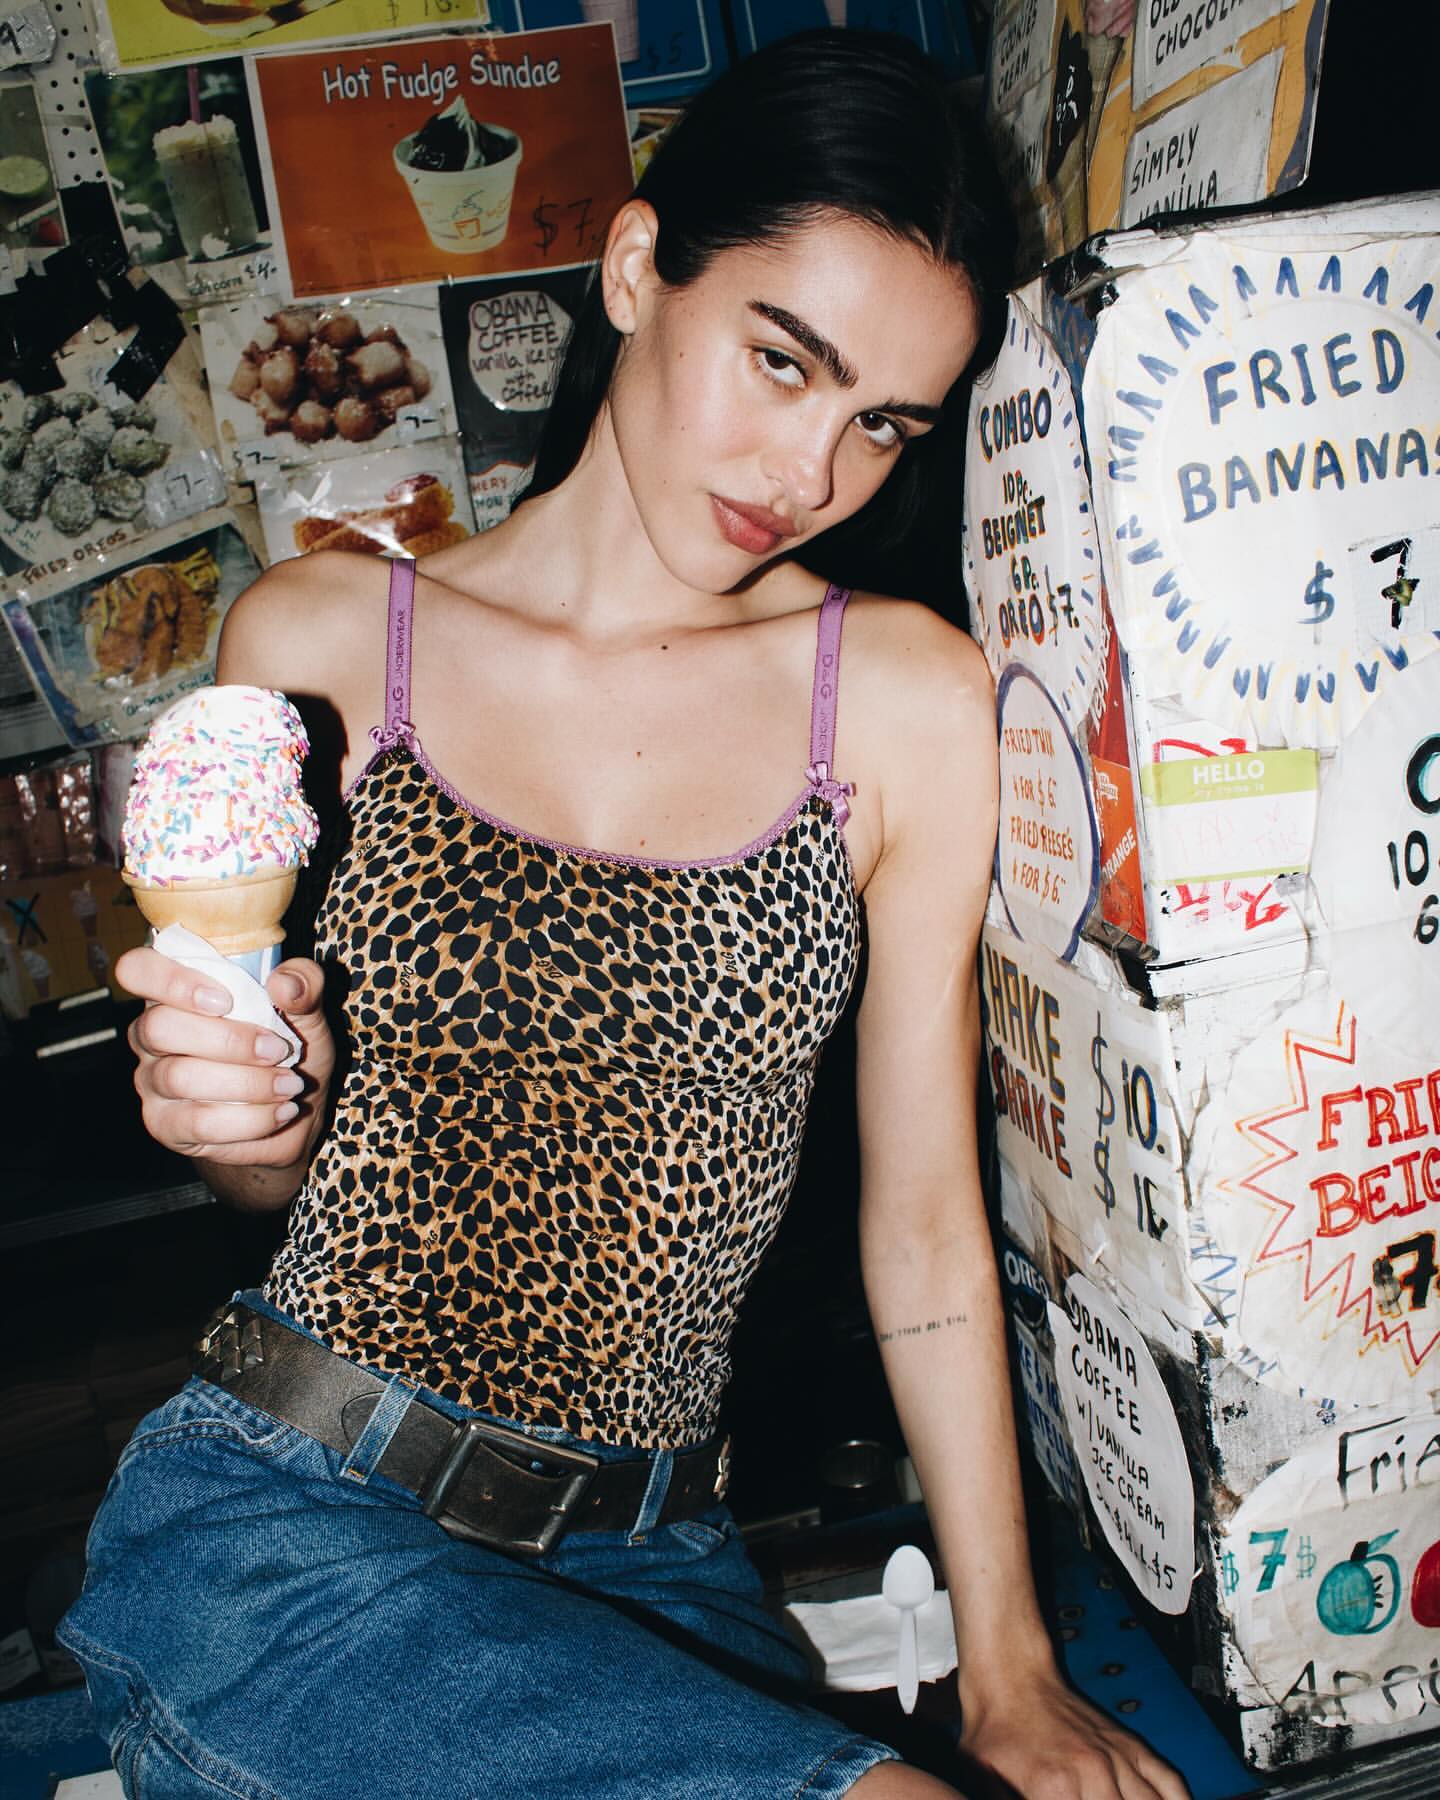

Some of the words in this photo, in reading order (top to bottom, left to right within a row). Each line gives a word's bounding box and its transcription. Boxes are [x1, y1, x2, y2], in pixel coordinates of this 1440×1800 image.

[323, 63, 371, 103] Hot
[382, 56, 458, 105] Fudge
[470, 54, 561, 89] Sundae
[472, 291, 553, 330] OBAMA
[478, 321, 559, 352] COFFEE
[1202, 327, 1406, 426] FRIED
[980, 386, 1052, 464] COMBO
[1176, 427, 1440, 524] BANANA
[981, 495, 1046, 561] BEIGNET
[22, 558, 68, 585] FRIED
[72, 528, 127, 561] OREOS
[998, 593, 1044, 649] OREO
[1004, 727, 1032, 756] FRIED
[1192, 758, 1265, 786] HELLO
[1010, 816, 1038, 850] FRIED
[1020, 862, 1039, 894] FOR
[1071, 1343, 1142, 1436] COFFEE
[1117, 1475, 1165, 1541] CREAM
